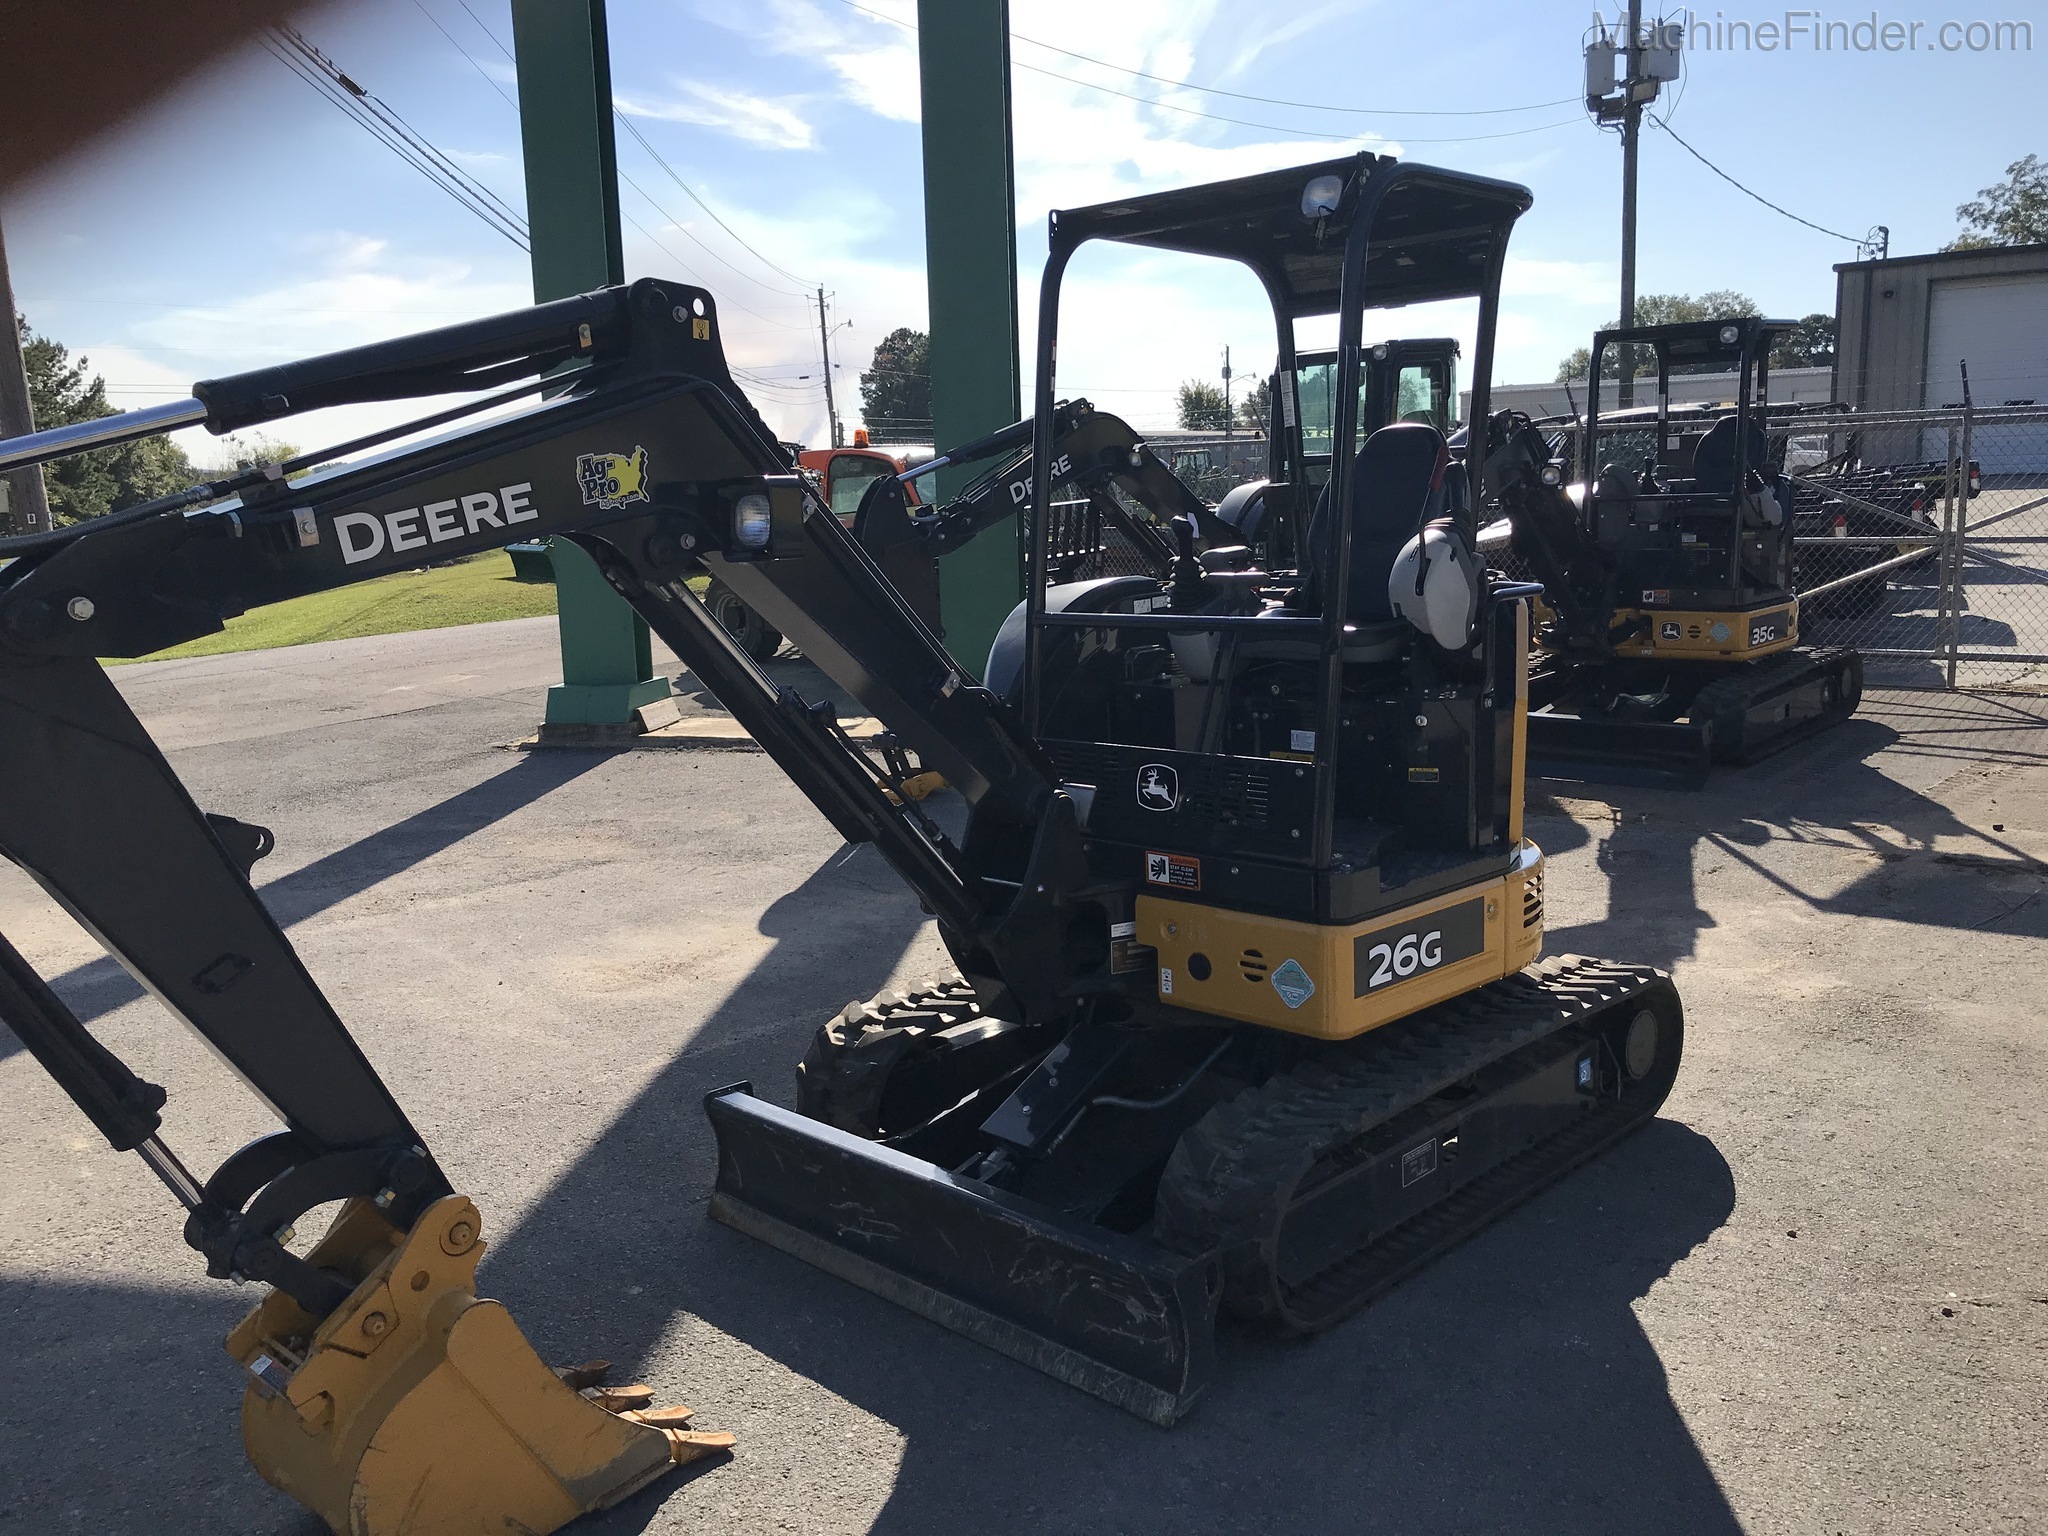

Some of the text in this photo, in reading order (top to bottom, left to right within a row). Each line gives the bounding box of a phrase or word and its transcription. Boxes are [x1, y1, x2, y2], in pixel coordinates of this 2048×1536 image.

[583, 478, 620, 501] Pro
[333, 482, 539, 565] DEERE
[1751, 625, 1775, 645] 35G
[1368, 930, 1442, 988] 26G
